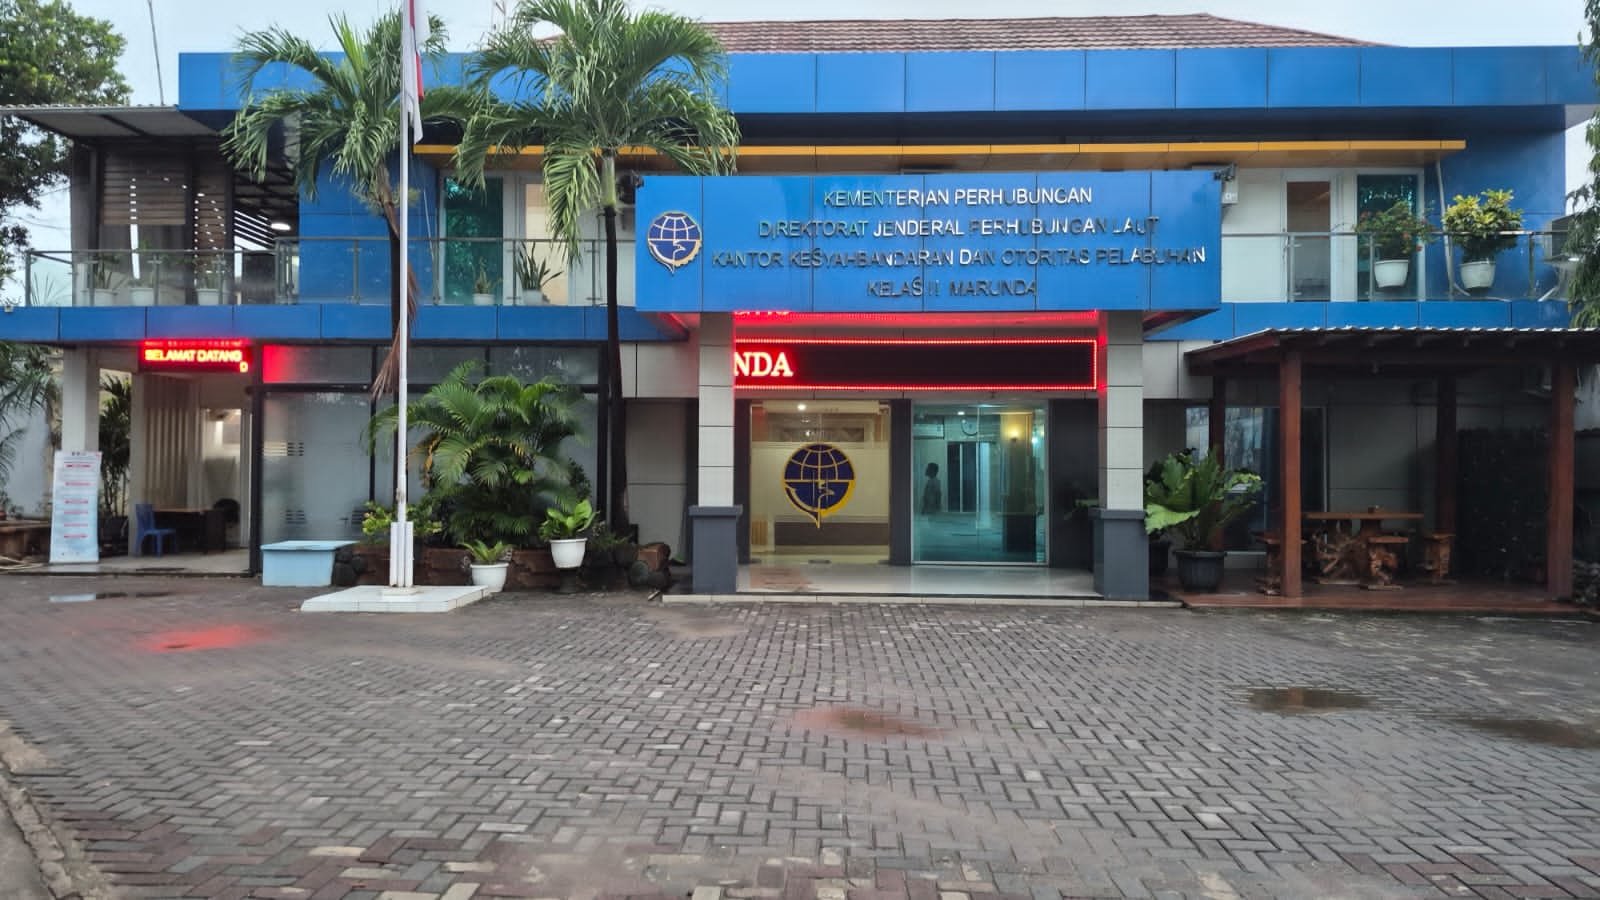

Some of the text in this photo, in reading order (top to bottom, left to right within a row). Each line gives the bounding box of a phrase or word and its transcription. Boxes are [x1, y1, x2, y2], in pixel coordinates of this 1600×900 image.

[823, 187, 1093, 208] KEMENTERIAN PERHUBUNGAN
[759, 216, 1160, 240] DIREKTORAT JENDERAL PERHUBUNGAN LAUT
[712, 247, 1206, 268] KANTOR KESYAHBANDARAN DAN OTORITAS PELABUHAN
[867, 276, 923, 297] KELAS
[949, 280, 1037, 297] MARUNDA
[144, 349, 196, 361] SELAMAT
[734, 351, 794, 377] NDA
